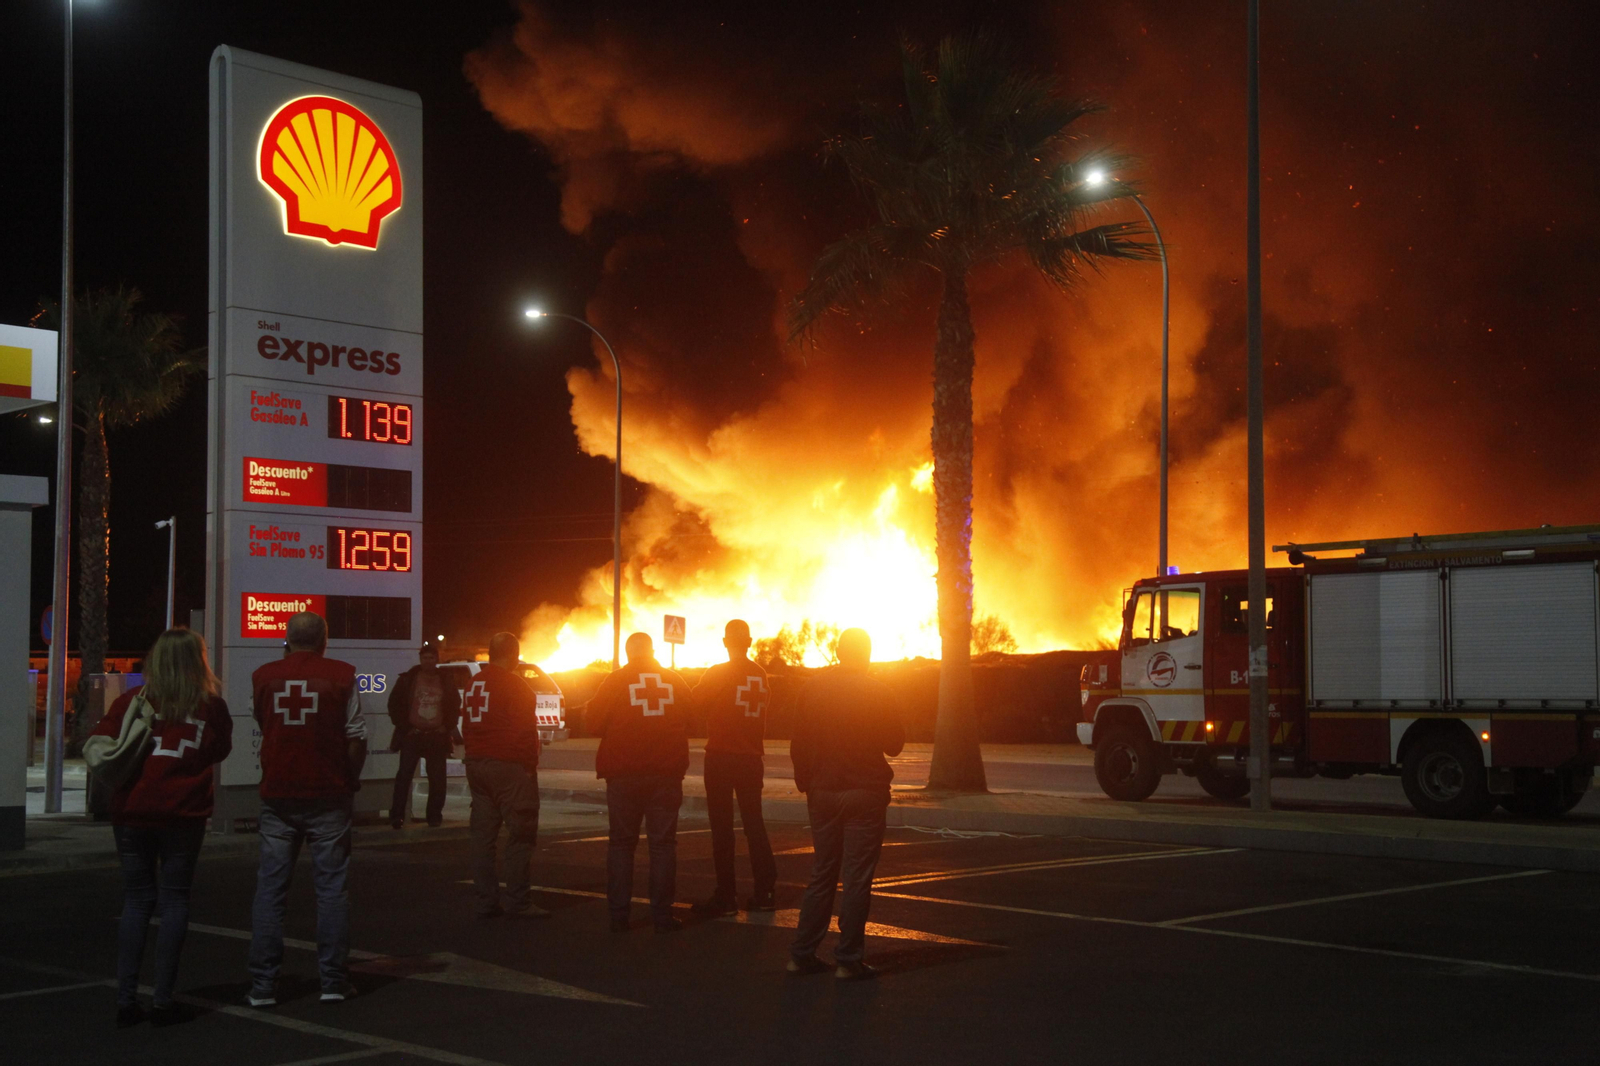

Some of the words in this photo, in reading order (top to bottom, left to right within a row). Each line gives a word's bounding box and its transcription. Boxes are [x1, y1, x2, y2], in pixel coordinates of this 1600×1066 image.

[257, 320, 280, 332] Shell
[257, 334, 402, 376] express
[250, 390, 302, 410] FuelSave
[250, 407, 297, 426] Gasóleo
[300, 412, 309, 427] A
[338, 397, 412, 444] 1.139
[249, 477, 277, 488] FuelSave
[274, 488, 280, 497] A
[249, 524, 301, 542] FuelSave
[249, 541, 267, 557] Sin
[270, 542, 306, 559] Plomo
[309, 544, 325, 560] 95
[337, 528, 411, 572] 1.259
[1435, 558, 1443, 568] Y
[1444, 555, 1503, 567] SALVAMENTO
[247, 612, 275, 622] FuelSave
[247, 621, 258, 631] Sin
[258, 622, 278, 631] Plomo
[278, 622, 287, 631] 95
